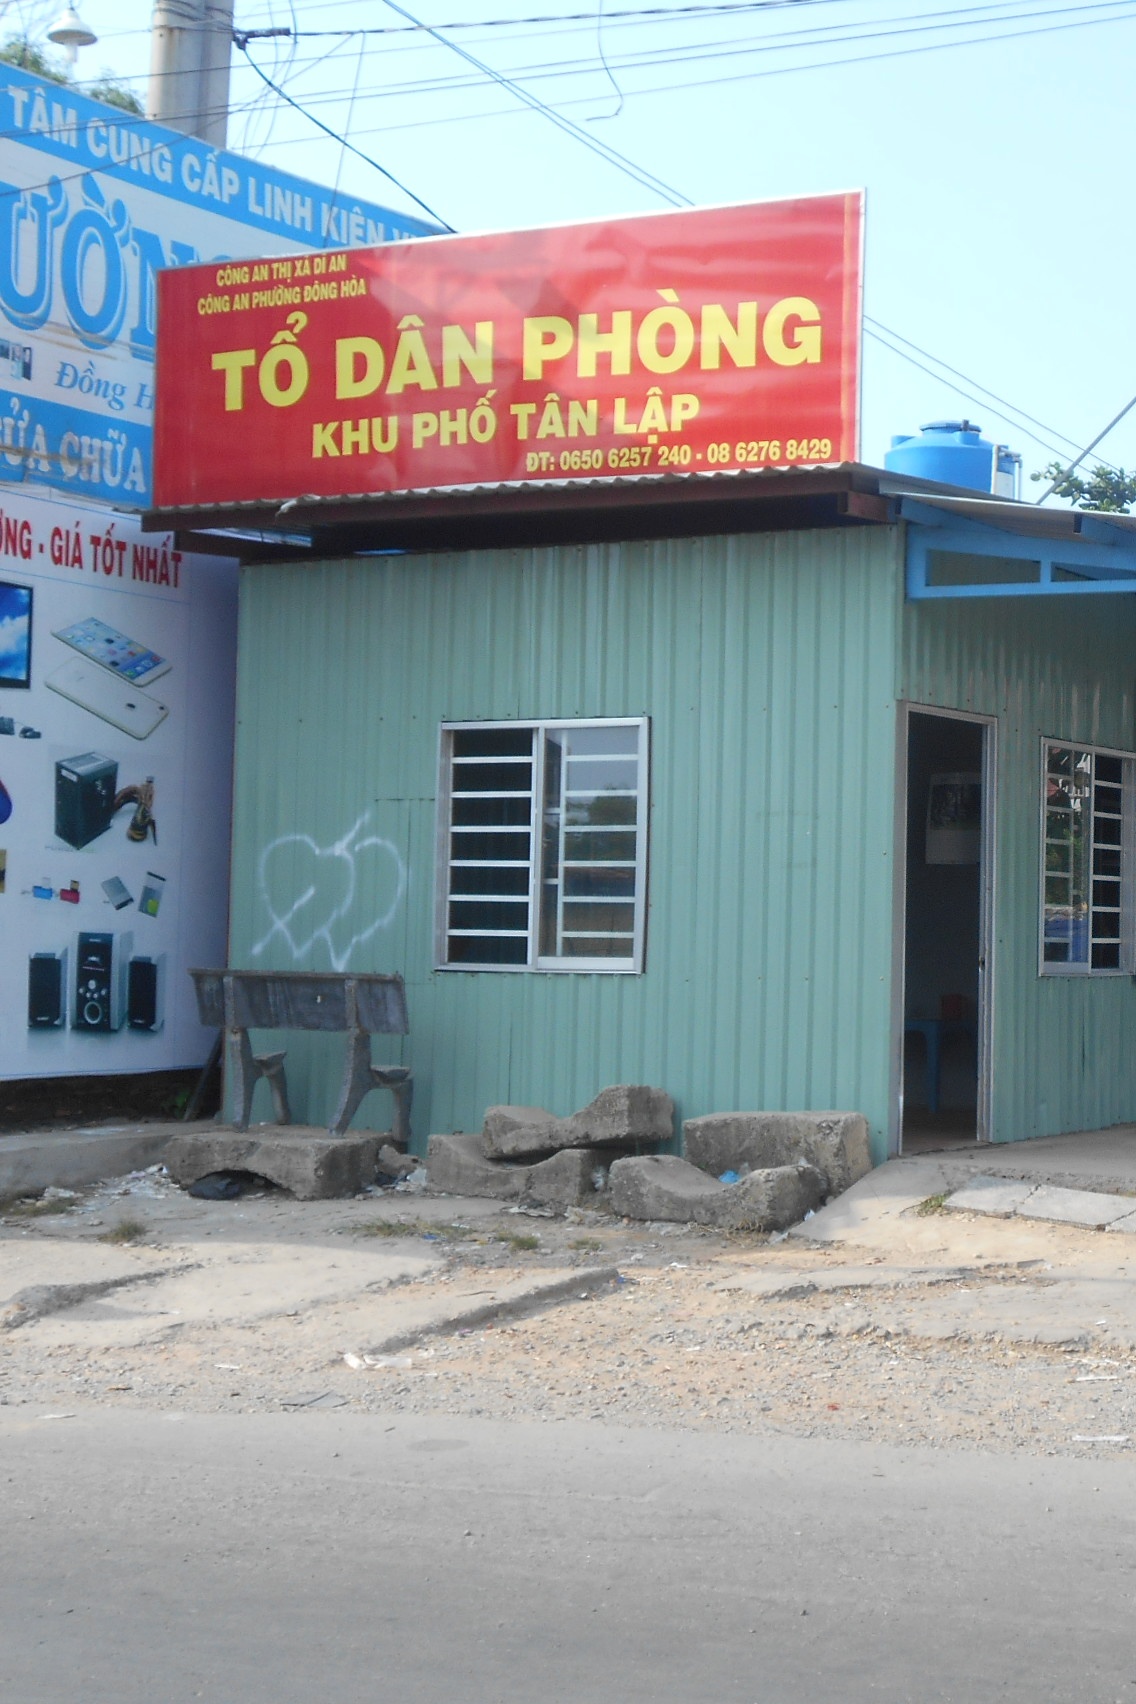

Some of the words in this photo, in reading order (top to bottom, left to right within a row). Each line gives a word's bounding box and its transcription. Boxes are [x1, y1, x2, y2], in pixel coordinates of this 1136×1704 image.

[7, 84, 78, 148] TÂM
[86, 119, 174, 184] CUNG
[181, 149, 240, 205] CẤP
[248, 177, 313, 233] LINH
[197, 293, 230, 315] CÔNG
[232, 293, 249, 311] AN
[252, 283, 301, 309] PHƯỜNG
[303, 280, 337, 302] ĐÔNG
[340, 274, 367, 297] HÒA
[216, 265, 249, 287] CÔNG
[252, 264, 269, 282] AN
[271, 261, 292, 283] THỊ
[328, 254, 347, 273] AN
[211, 311, 309, 411] TỔ
[335, 314, 494, 400] DÂN
[522, 288, 822, 381] PHÒNG
[54, 360, 127, 411] Đồng
[0, 397, 50, 472] ỬA
[60, 428, 146, 493] CHỮA
[311, 415, 398, 458] KHU
[412, 389, 497, 449] PHỐ
[510, 392, 598, 440] TÂN
[613, 386, 700, 444] LẬP
[526, 451, 555, 472] ĐT:
[559, 450, 604, 471] 0650
[607, 447, 652, 468] 6257
[658, 444, 691, 466] 240
[707, 442, 730, 464] 08
[735, 440, 781, 462] 6276
[785, 438, 832, 460] 8429
[51, 521, 83, 570] GIÁ
[90, 523, 127, 577] TỐT
[132, 535, 182, 588] NHẤT
